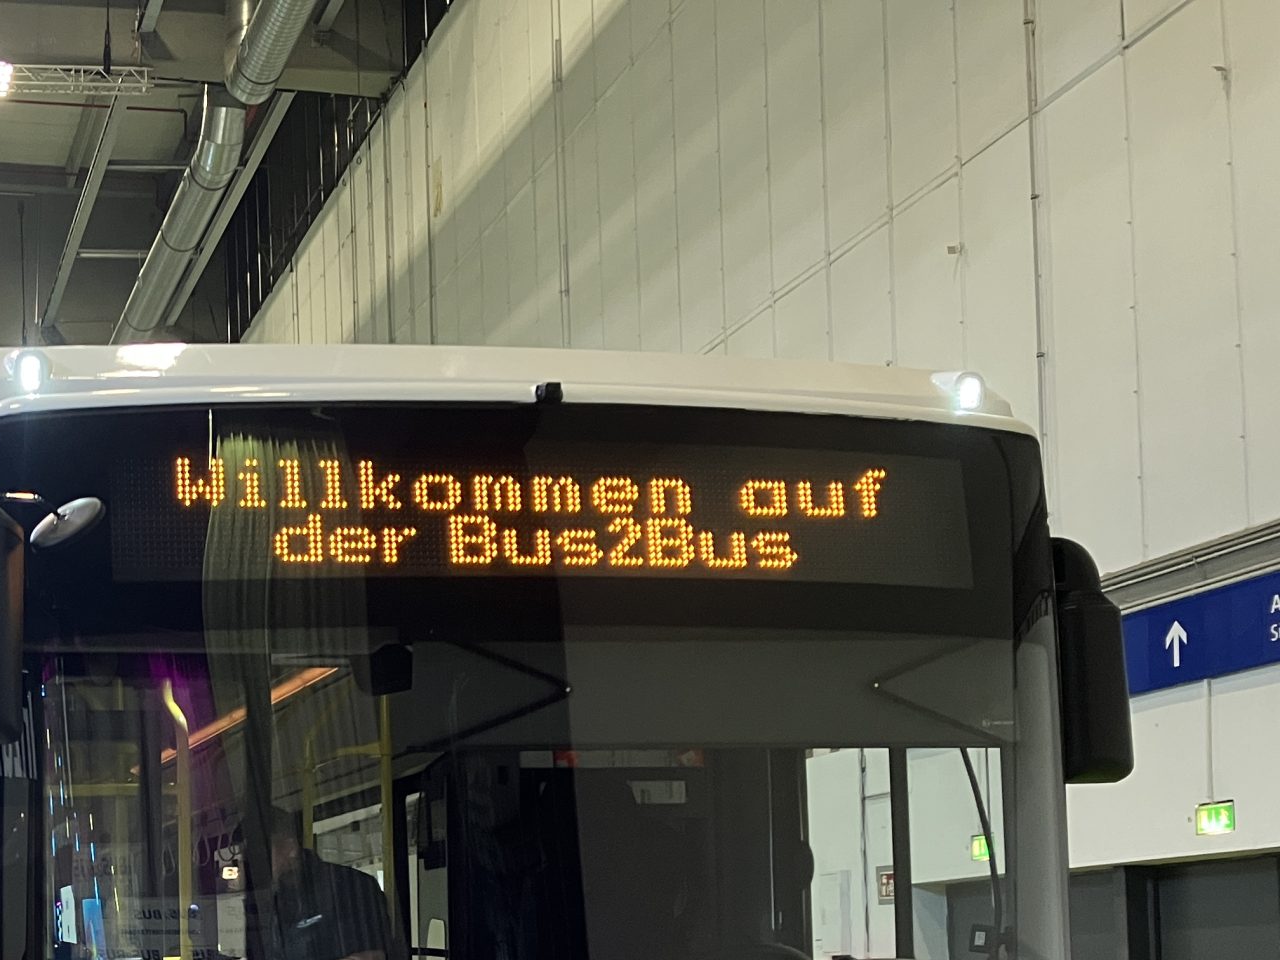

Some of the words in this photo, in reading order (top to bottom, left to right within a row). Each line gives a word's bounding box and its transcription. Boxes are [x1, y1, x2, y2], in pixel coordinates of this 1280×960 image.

[174, 456, 693, 516] Willkommen
[740, 467, 888, 519] auf
[273, 513, 416, 565] der
[448, 515, 799, 572] Bus2Bus
